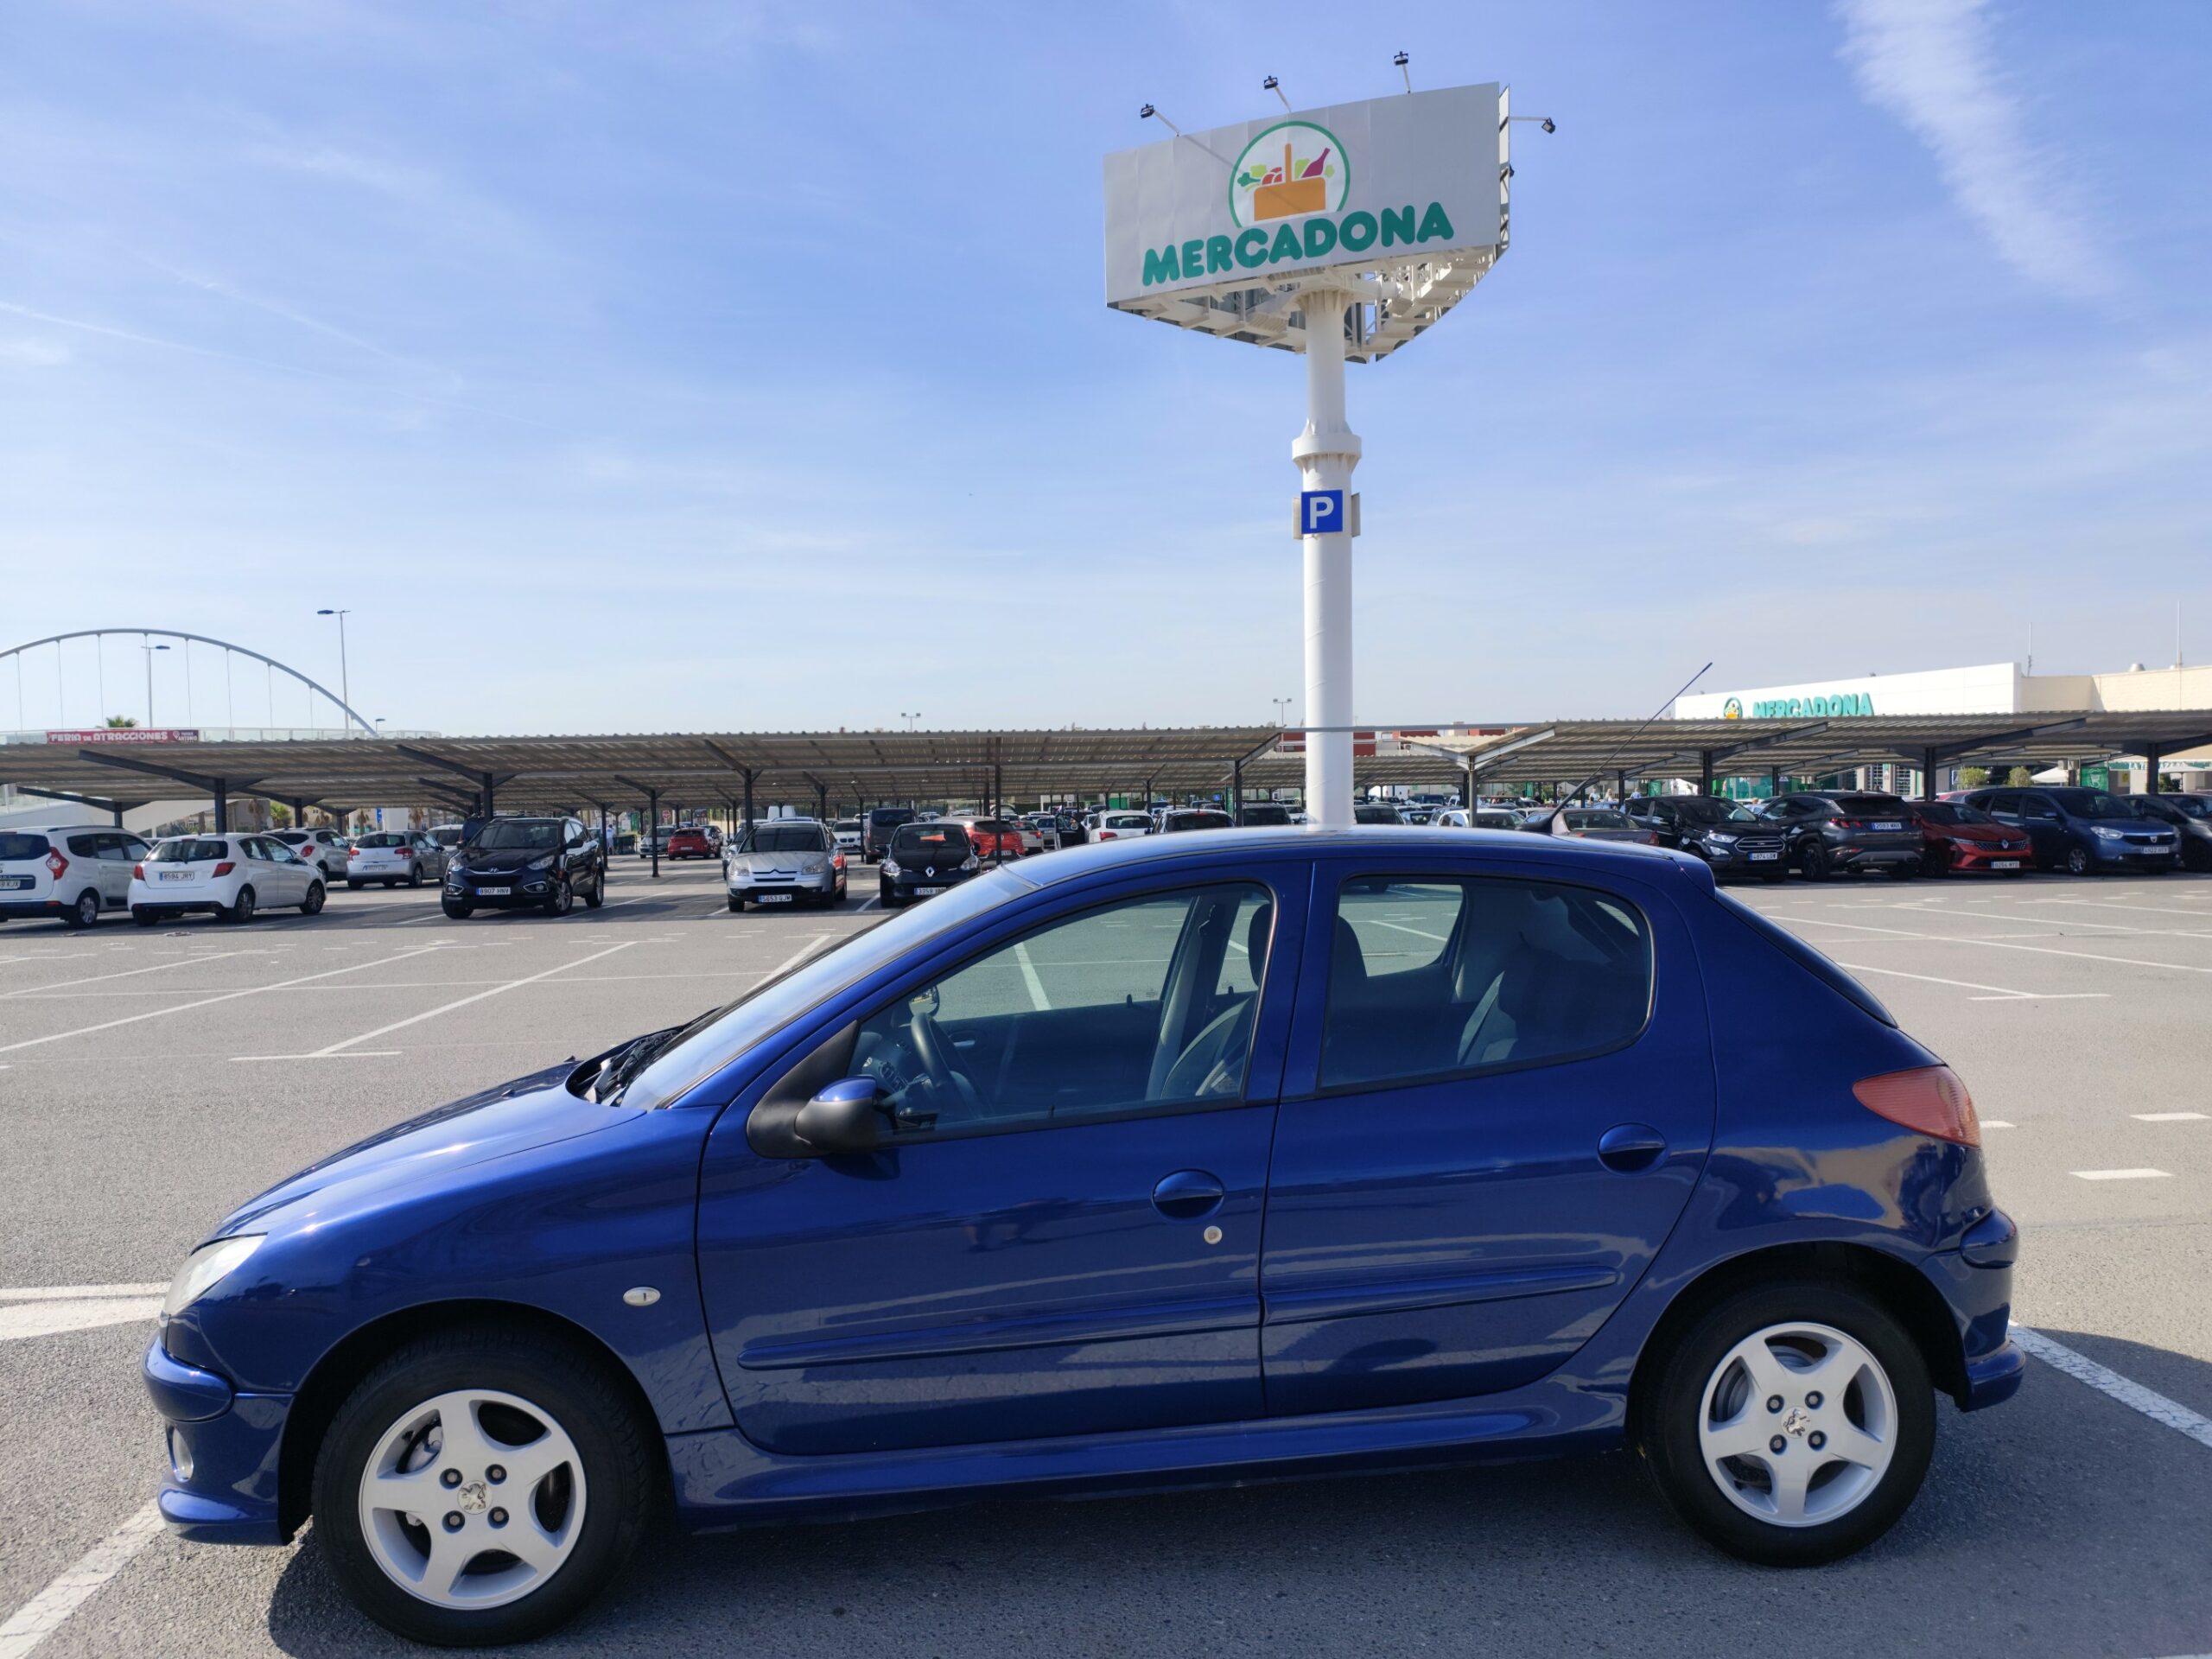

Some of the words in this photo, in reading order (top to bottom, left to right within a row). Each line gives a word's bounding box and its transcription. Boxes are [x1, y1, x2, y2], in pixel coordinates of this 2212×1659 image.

[1142, 201, 1454, 287] MERCADONA
[1310, 497, 1334, 529] P
[1752, 692, 1874, 717] MERCADONA
[93, 732, 168, 741] ATRACCIONES
